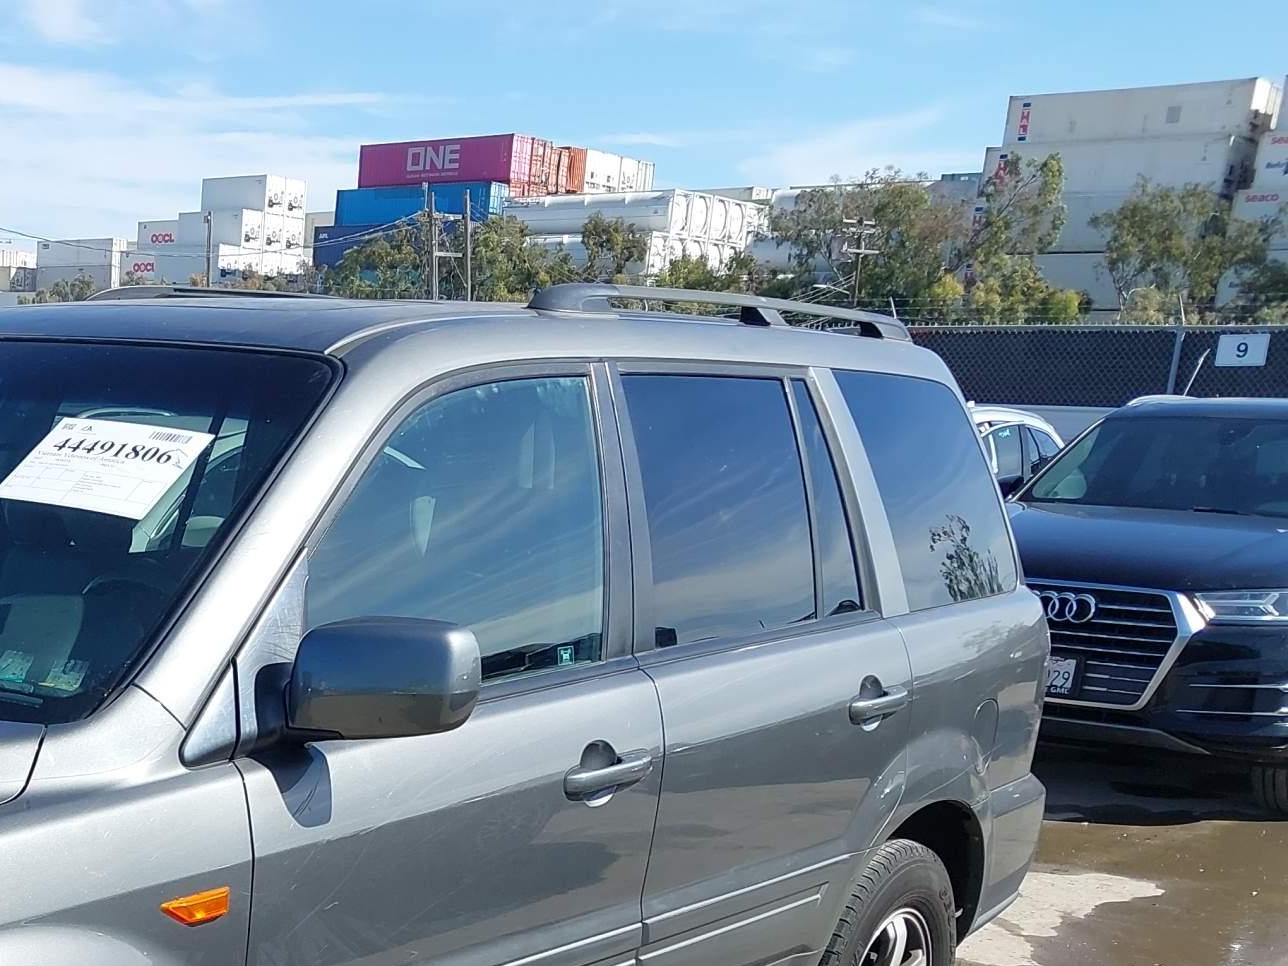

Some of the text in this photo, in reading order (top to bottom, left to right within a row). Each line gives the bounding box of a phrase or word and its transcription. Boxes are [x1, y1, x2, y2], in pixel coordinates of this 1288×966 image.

[406, 144, 461, 172] ONE
[150, 232, 175, 244] OOCL
[1235, 342, 1249, 358] 9
[52, 437, 172, 465] 44491806
[1048, 669, 1071, 689] 29
